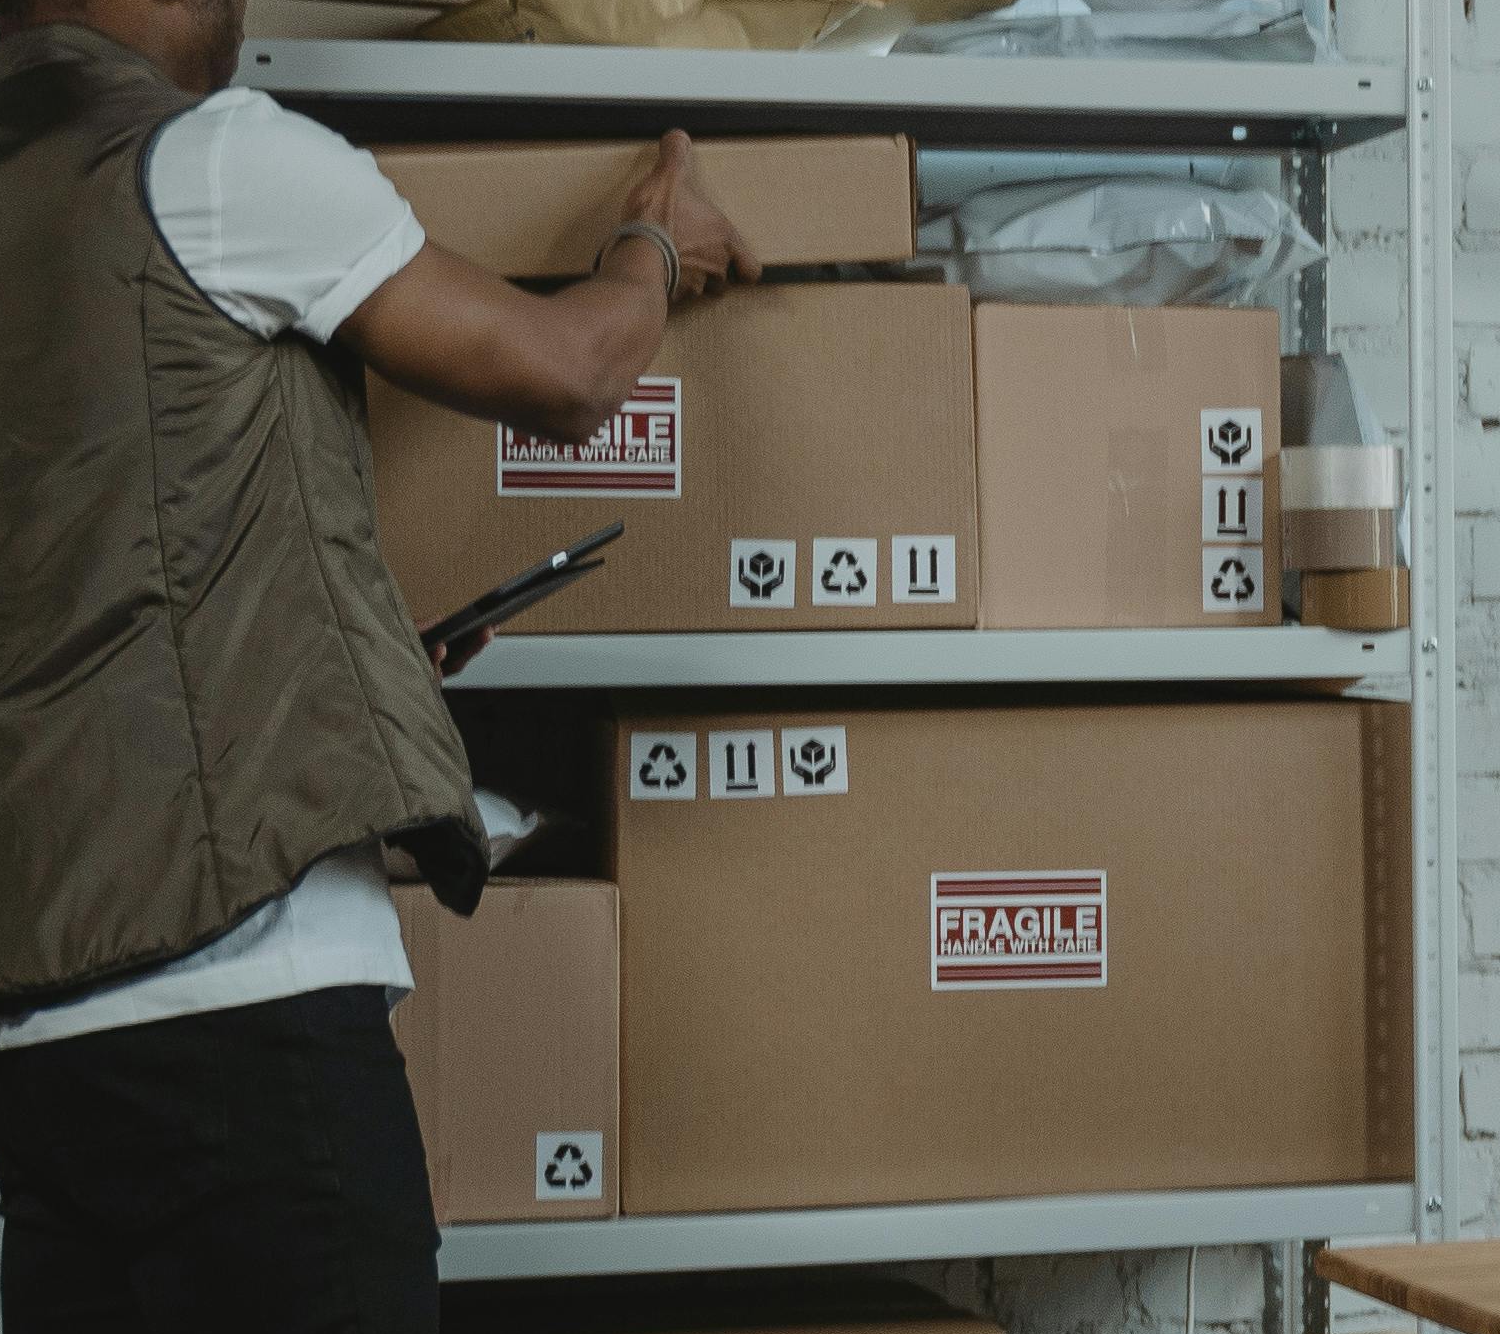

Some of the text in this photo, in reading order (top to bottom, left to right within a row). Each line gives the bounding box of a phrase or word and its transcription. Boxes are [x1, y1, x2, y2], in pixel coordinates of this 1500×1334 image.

[506, 444, 671, 462] HANDLE WITH CARE
[940, 907, 1098, 941] FRAGILE
[940, 939, 1005, 955] HANDLE
[1010, 938, 1049, 954] WITH
